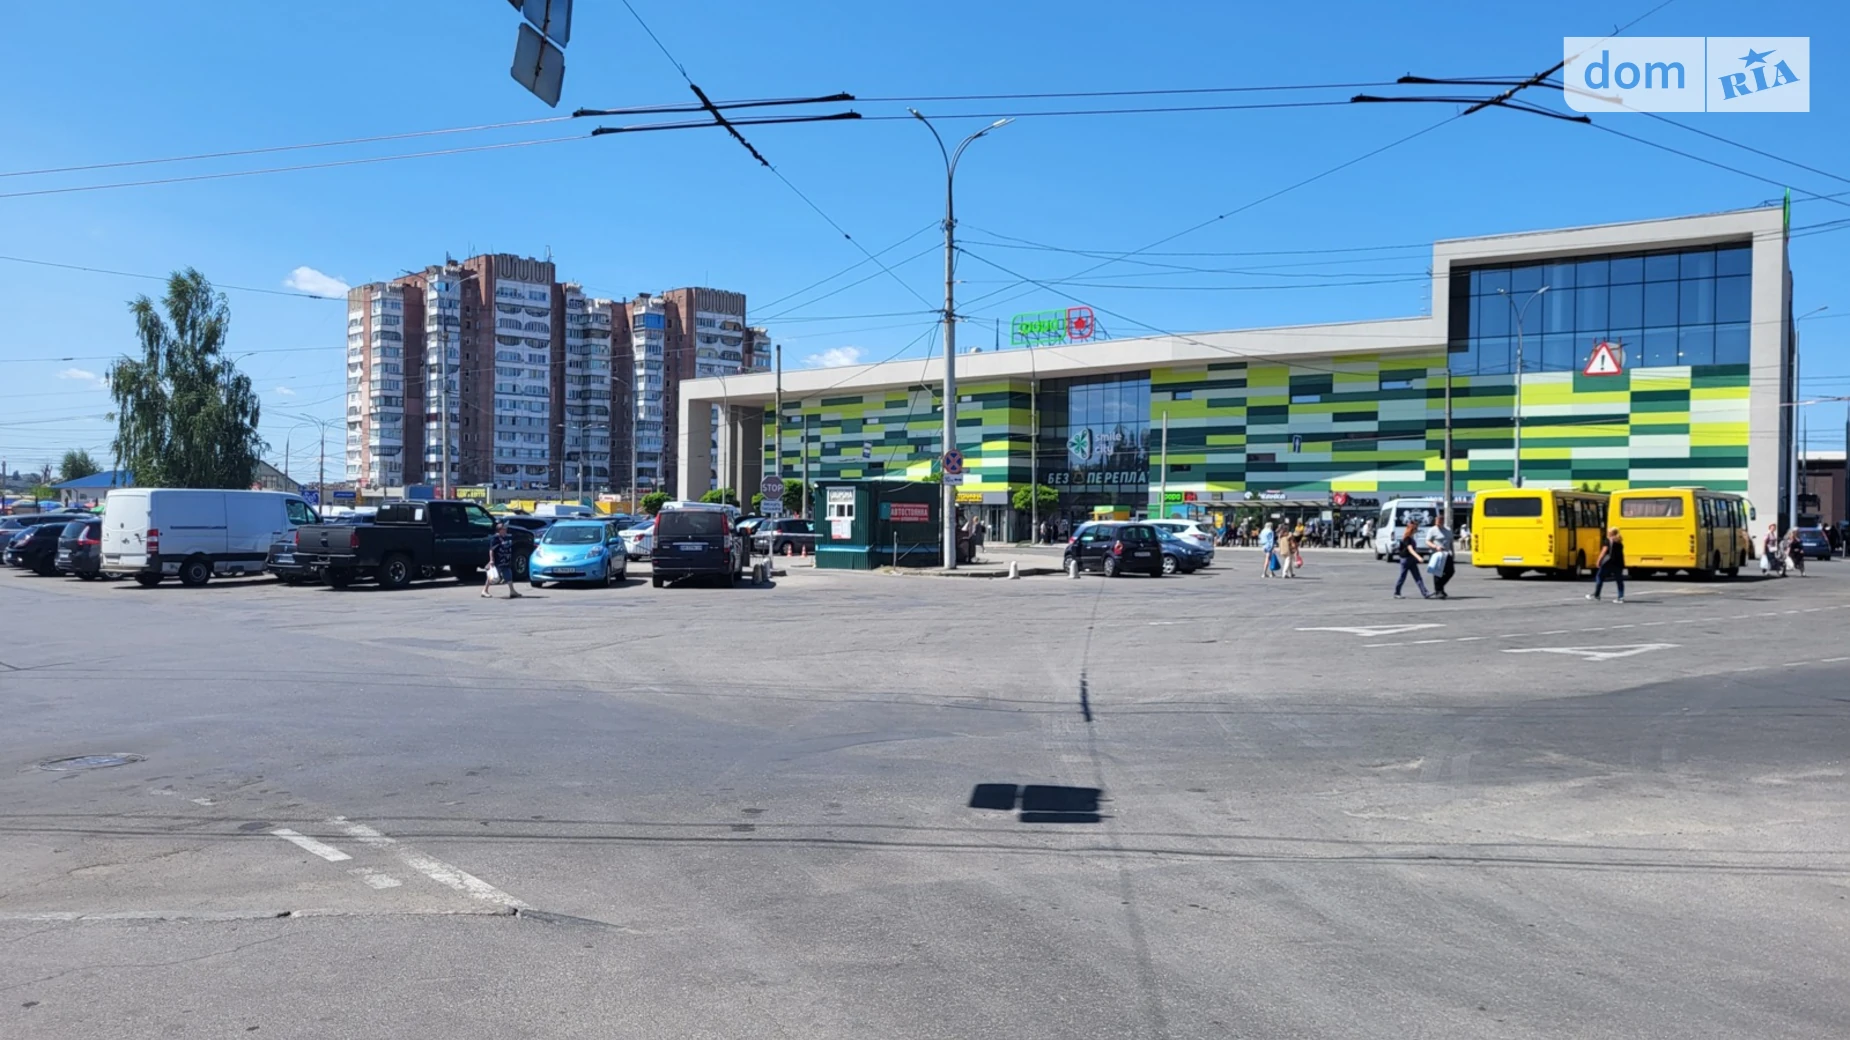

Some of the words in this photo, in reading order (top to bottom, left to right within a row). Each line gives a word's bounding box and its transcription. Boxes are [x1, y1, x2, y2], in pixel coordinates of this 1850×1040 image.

[1095, 432, 1122, 441] smile
[1094, 443, 1114, 456] city
[1047, 472, 1069, 484] БЕЗ
[762, 484, 783, 493] STOP
[890, 507, 929, 517] АВТОСТОЯНКА
